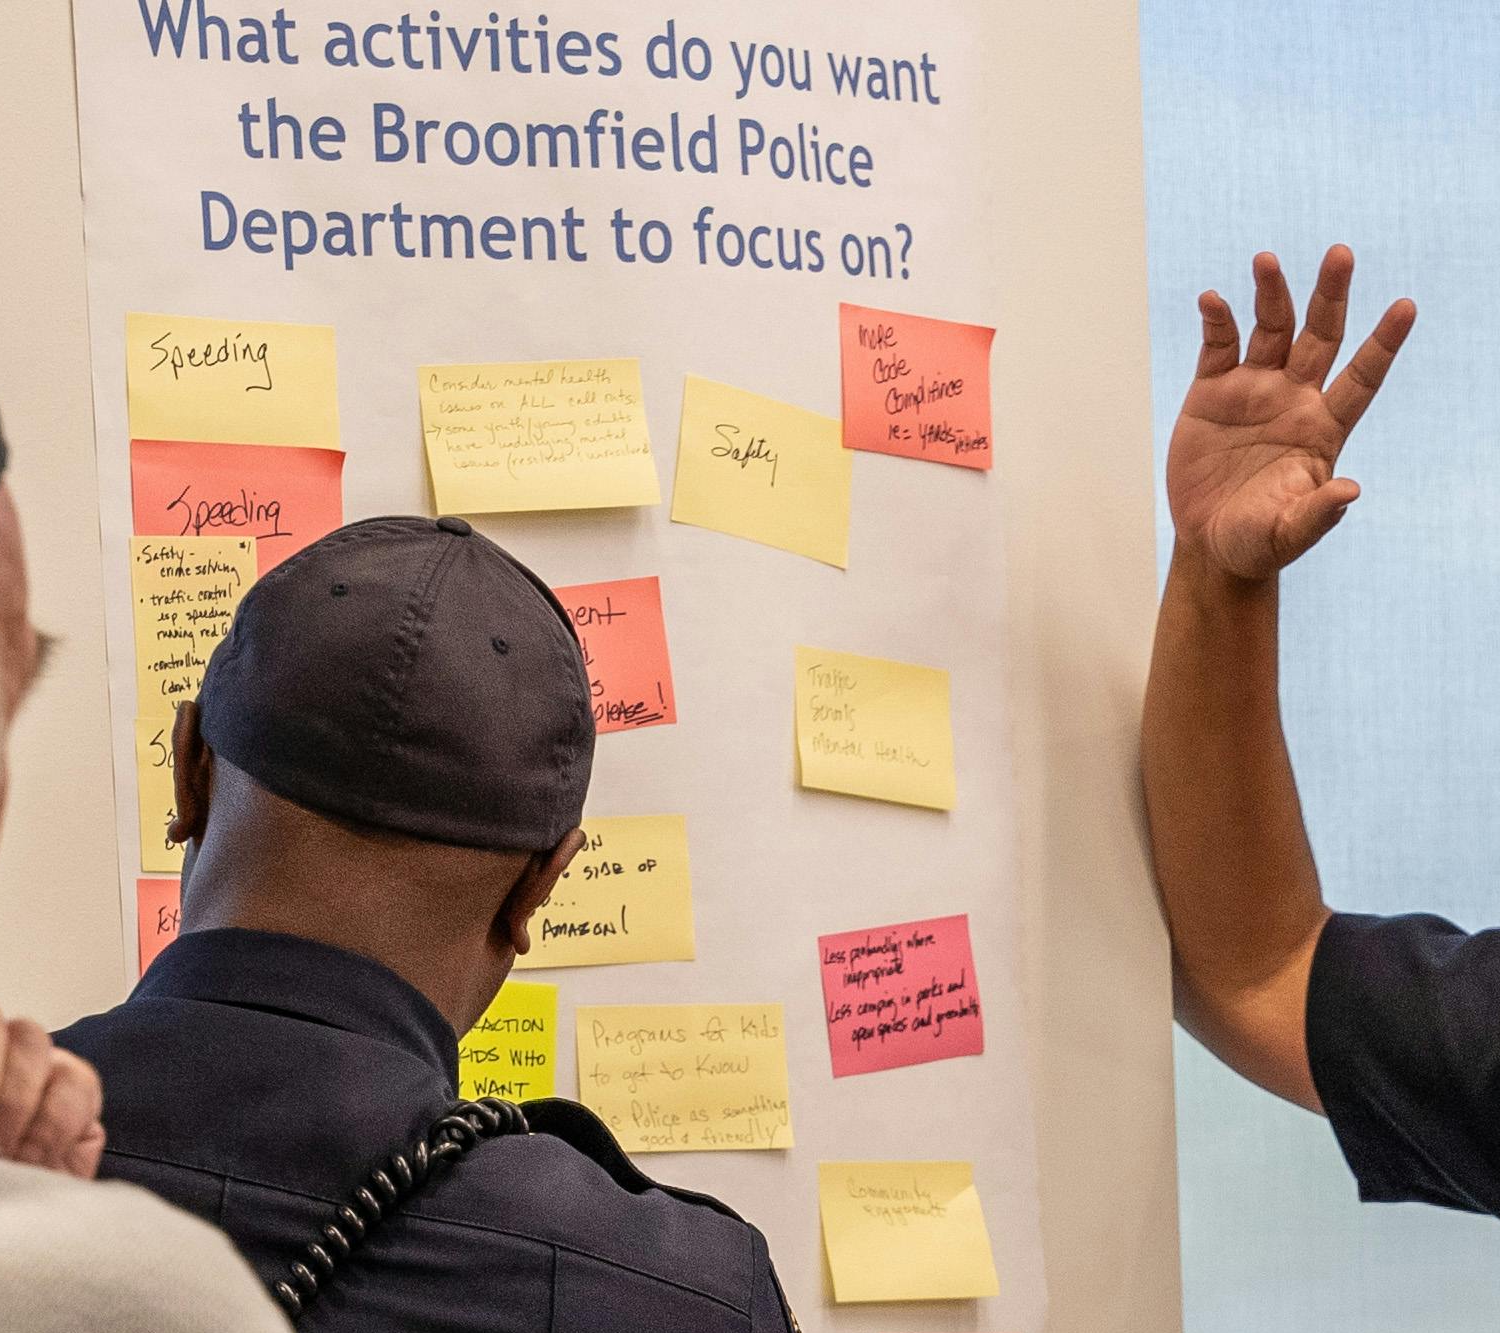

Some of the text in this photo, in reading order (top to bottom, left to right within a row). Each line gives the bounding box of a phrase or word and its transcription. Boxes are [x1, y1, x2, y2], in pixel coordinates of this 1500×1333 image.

[139, 0, 941, 105] What activities do you want
[238, 96, 875, 189] the Broomfield Police
[200, 190, 914, 281] Department to focus on?
[150, 332, 273, 391] Speeding
[503, 369, 553, 388] mental
[559, 366, 612, 386] health
[873, 353, 912, 385] Code
[519, 393, 556, 411] ALL
[710, 423, 779, 489] Safety
[166, 485, 293, 539] Speeding
[150, 588, 194, 607] traffic
[200, 623, 219, 638] red
[592, 1019, 687, 1056] Programs
[509, 1048, 546, 1067] WHO
[473, 1077, 531, 1098] WANT
[589, 1063, 610, 1087] to
[621, 1062, 653, 1094] get
[659, 1061, 685, 1081] to
